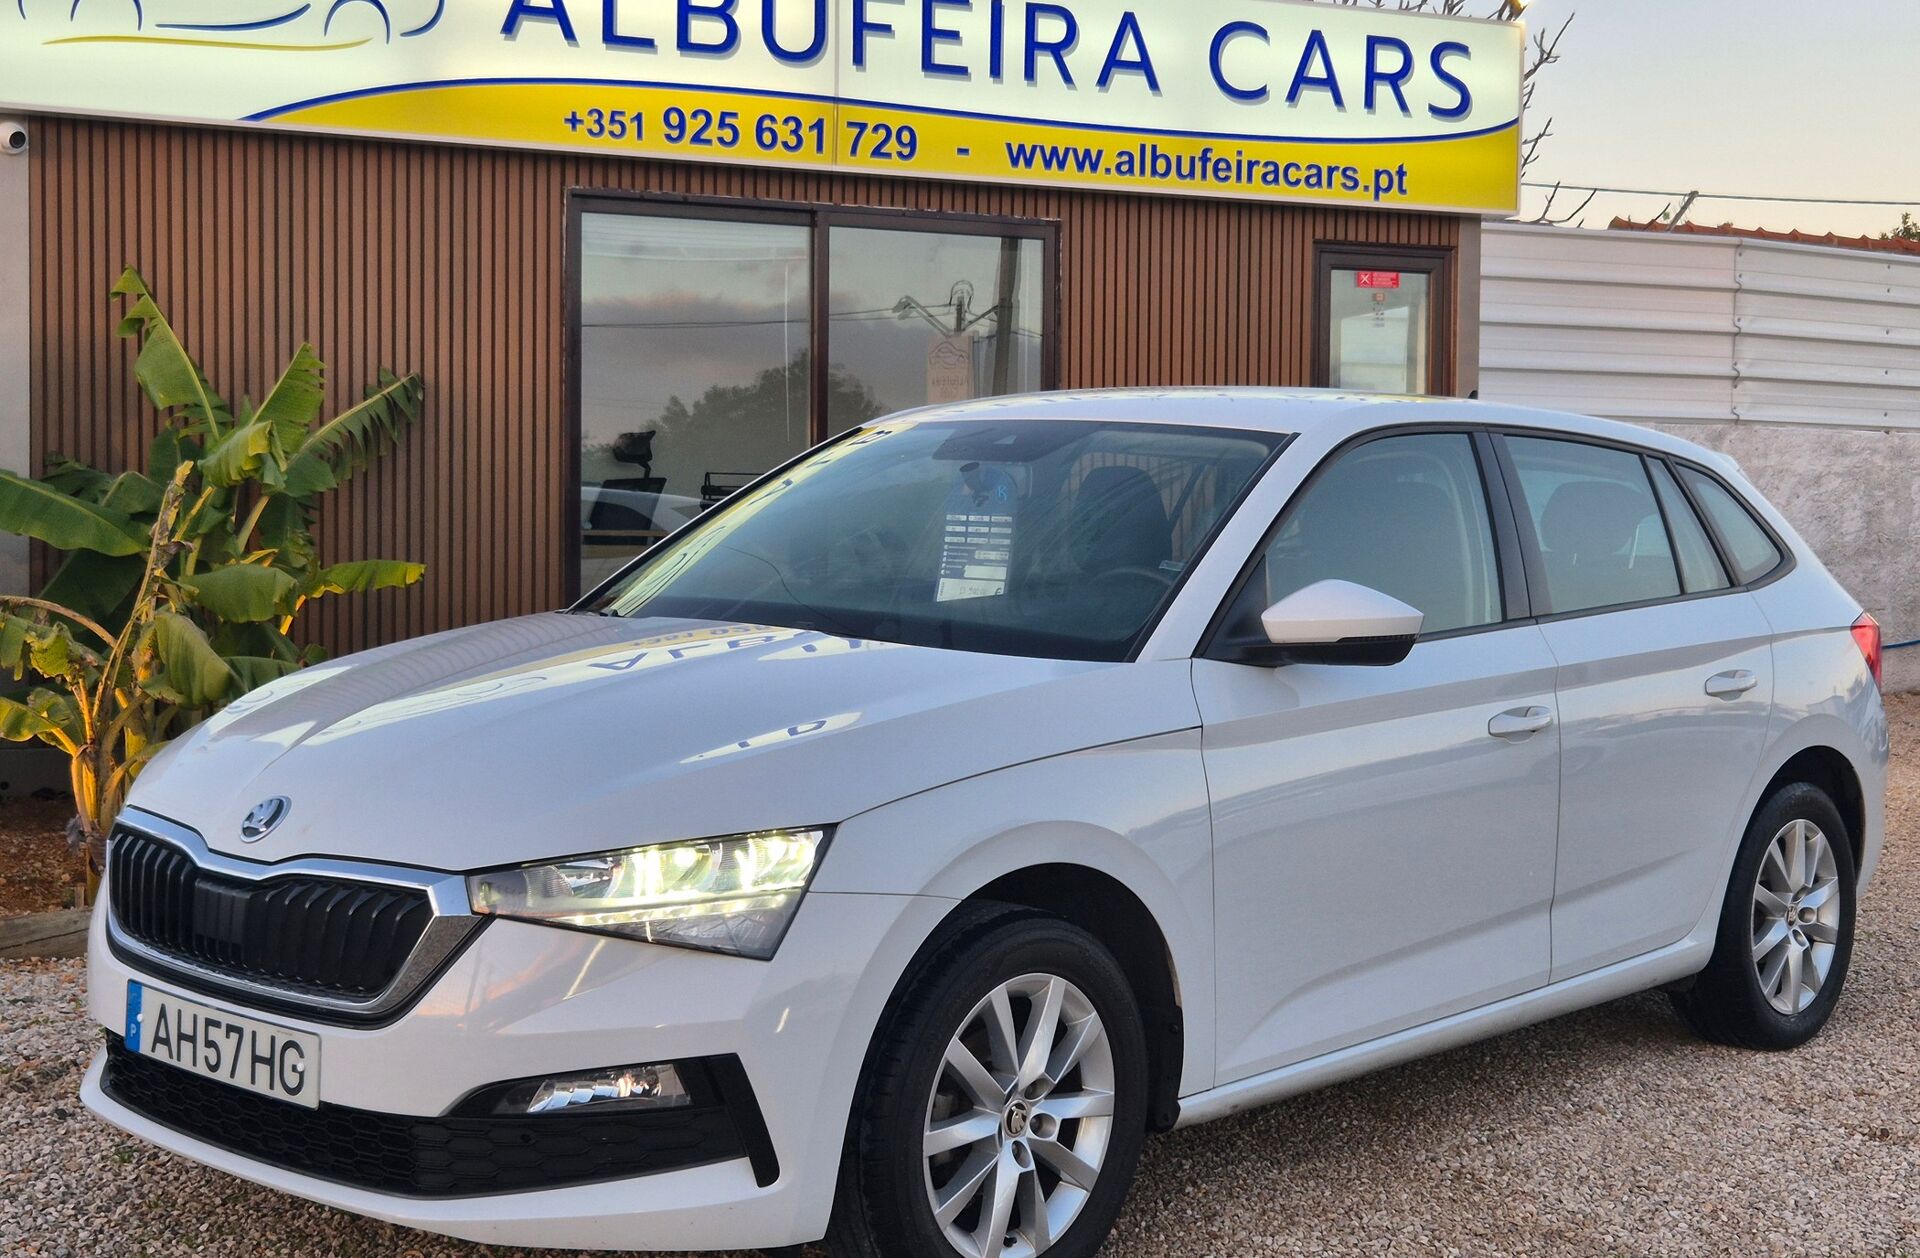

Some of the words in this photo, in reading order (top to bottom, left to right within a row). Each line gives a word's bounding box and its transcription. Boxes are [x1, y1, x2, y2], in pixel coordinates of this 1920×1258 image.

[1208, 21, 1472, 119] CARS
[564, 108, 644, 141] +351
[663, 106, 740, 147] 925
[755, 114, 825, 154] 631
[846, 121, 918, 161] 729
[1006, 142, 1408, 199] www.albufeiracars.pt
[151, 1003, 305, 1096] AH57HG
